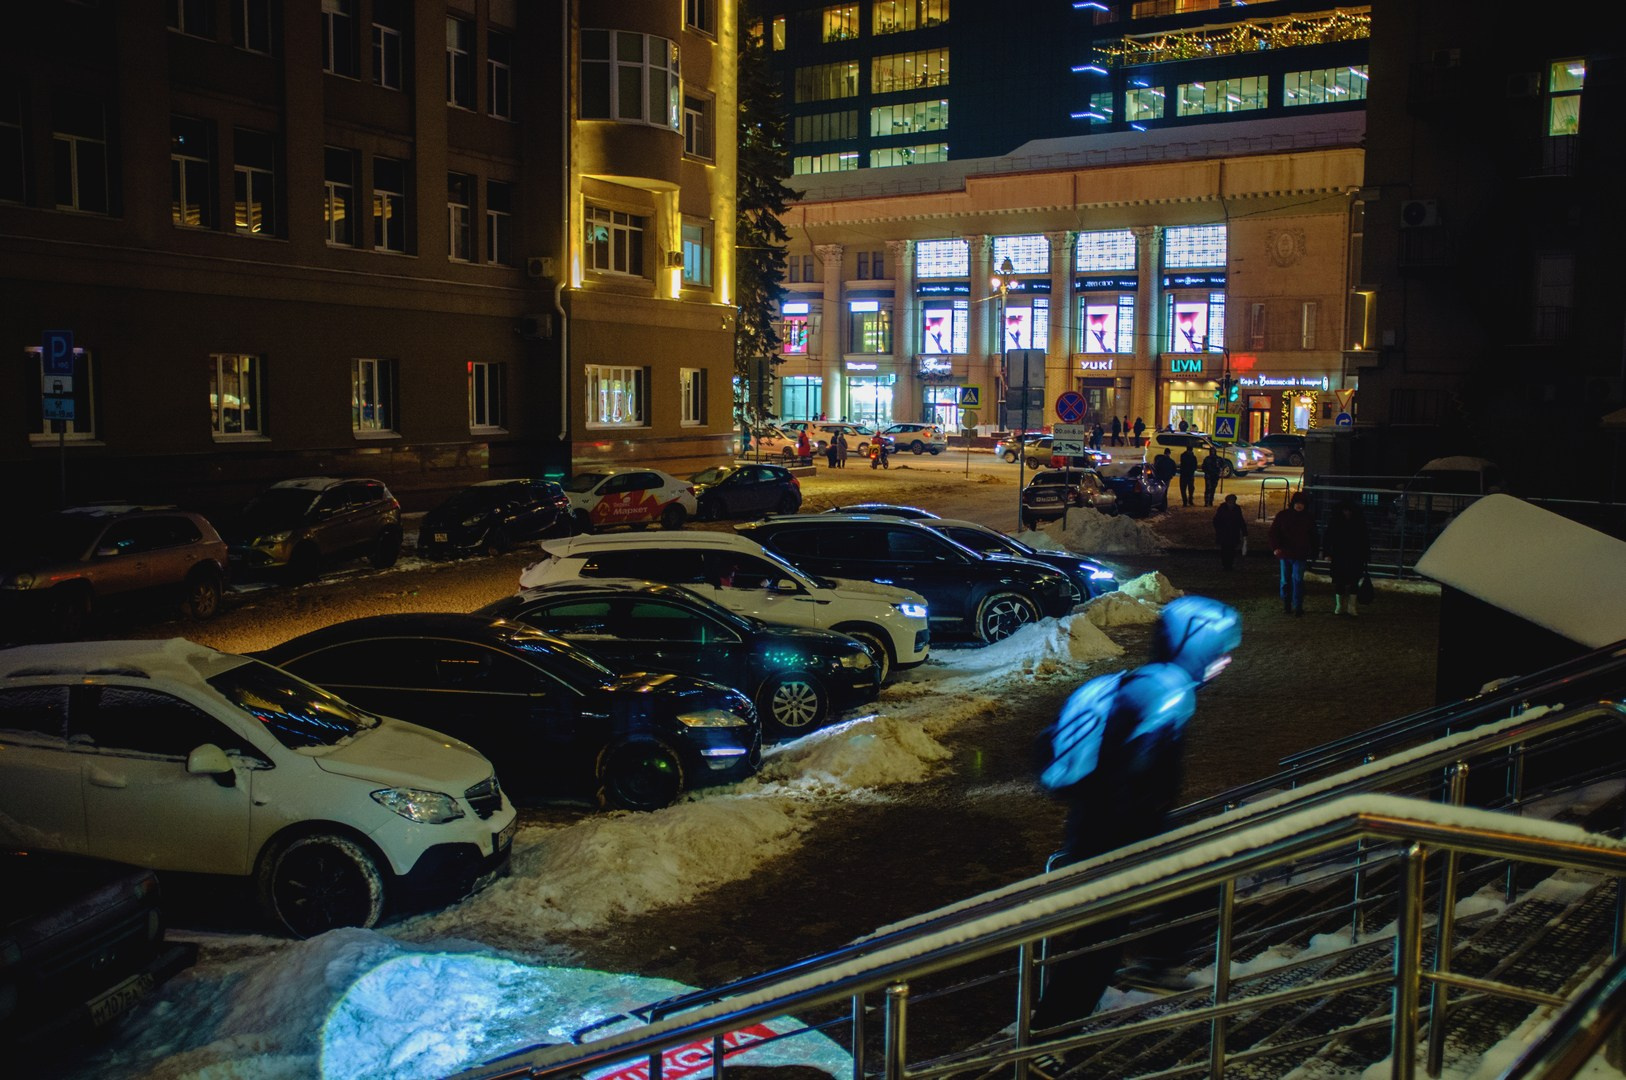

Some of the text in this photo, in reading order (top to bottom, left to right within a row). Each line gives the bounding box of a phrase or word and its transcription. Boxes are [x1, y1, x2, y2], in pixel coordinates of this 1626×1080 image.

[51, 336, 66, 368] P
[1171, 359, 1202, 373] ЦУМ
[613, 507, 648, 515] Маркет
